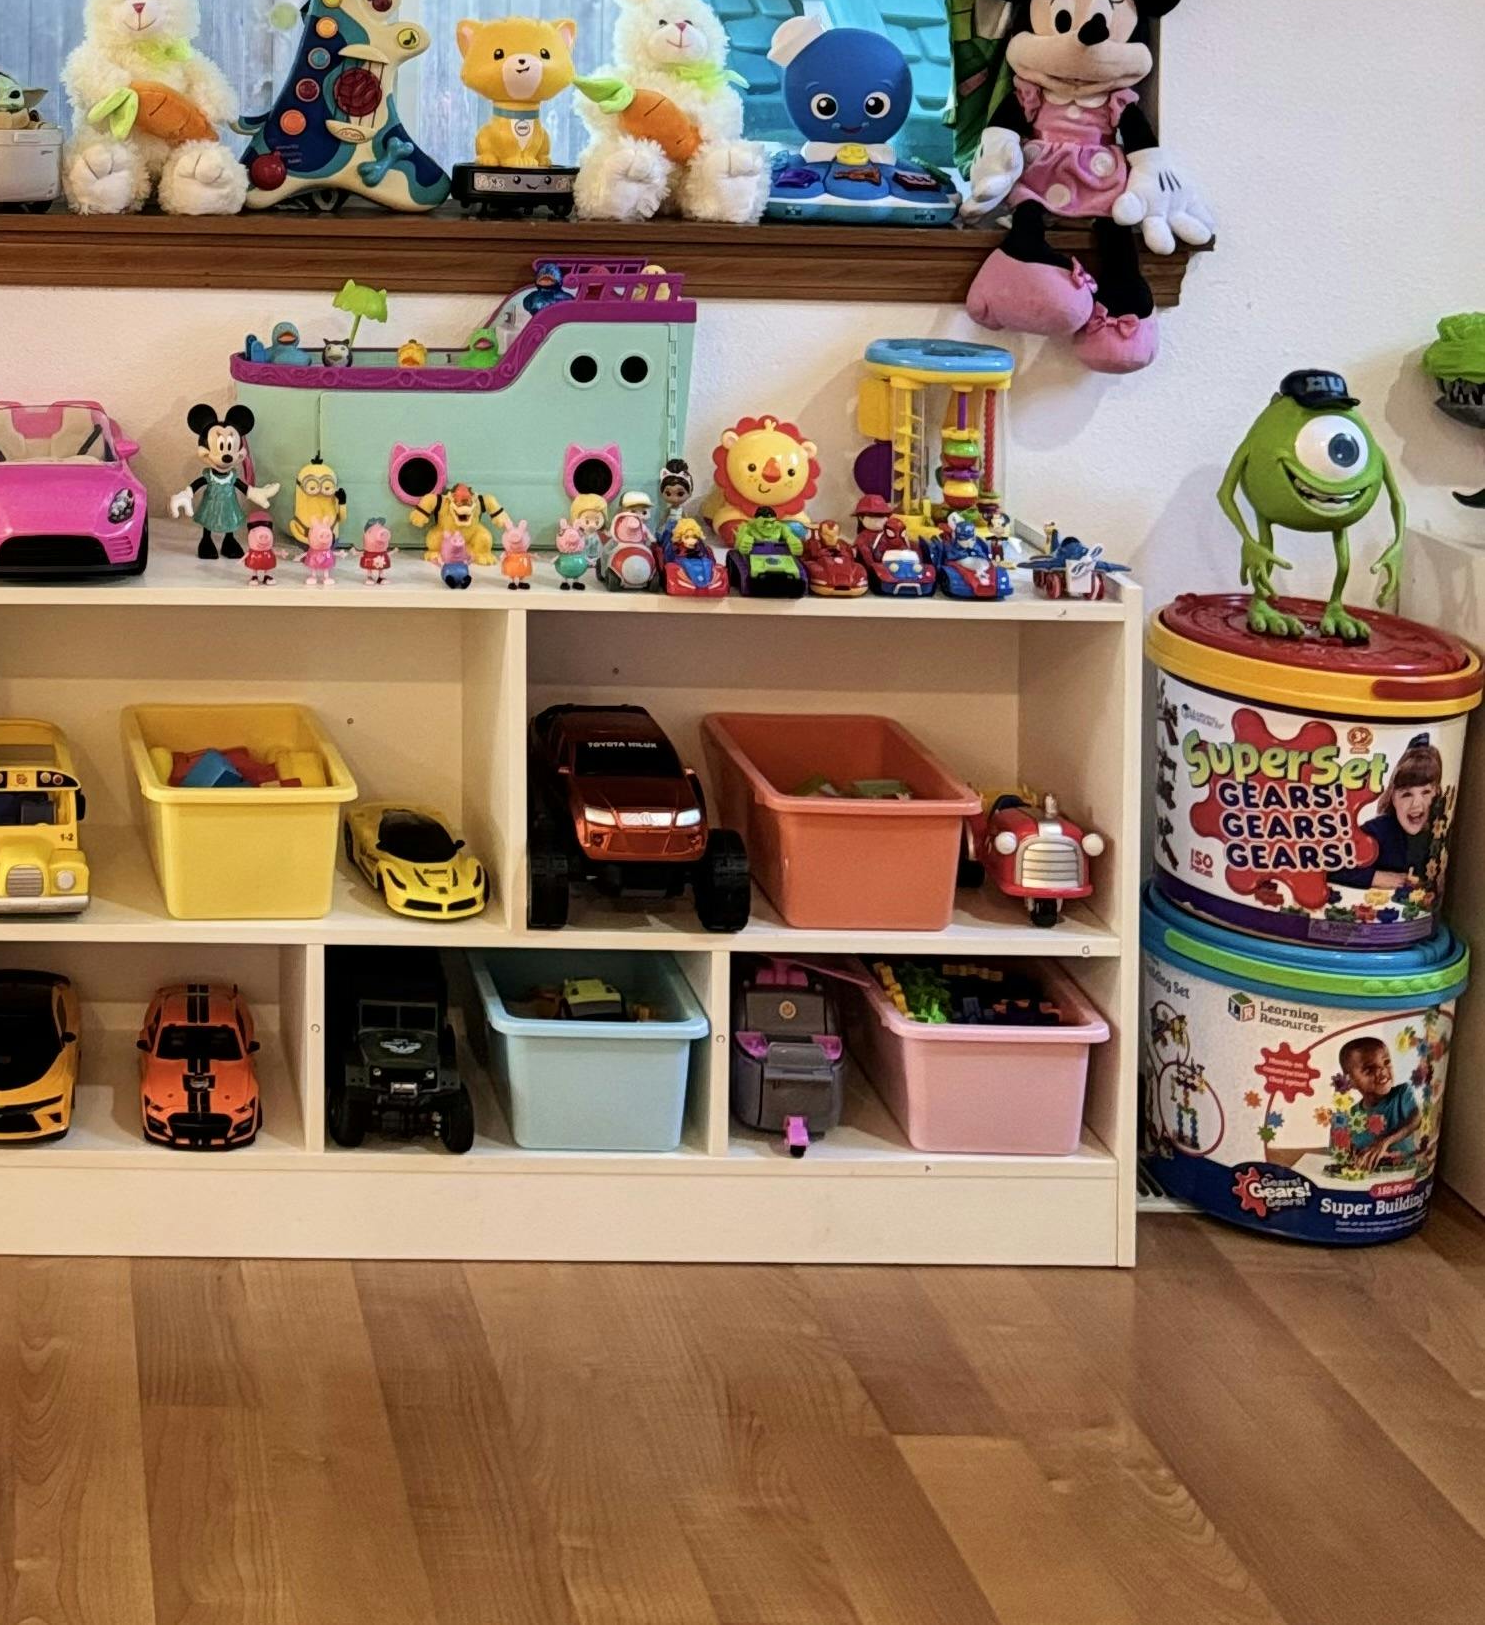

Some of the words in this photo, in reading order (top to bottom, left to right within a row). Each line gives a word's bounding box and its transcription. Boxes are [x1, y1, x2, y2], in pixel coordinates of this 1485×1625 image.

[1305, 376, 1345, 393] MU
[1217, 781, 1347, 810] GEARS!
[60, 833, 74, 841] 1-2
[1222, 812, 1351, 841] GEARS!
[1190, 847, 1214, 869] 150
[1226, 842, 1355, 870] GEARS!
[1260, 1001, 1319, 1023] Learning
[1260, 1013, 1324, 1033] Resources
[1248, 1181, 1312, 1199] Gears!
[1261, 1175, 1303, 1187] Gears!
[1319, 1197, 1373, 1219] Super
[1374, 1192, 1425, 1216] Building
